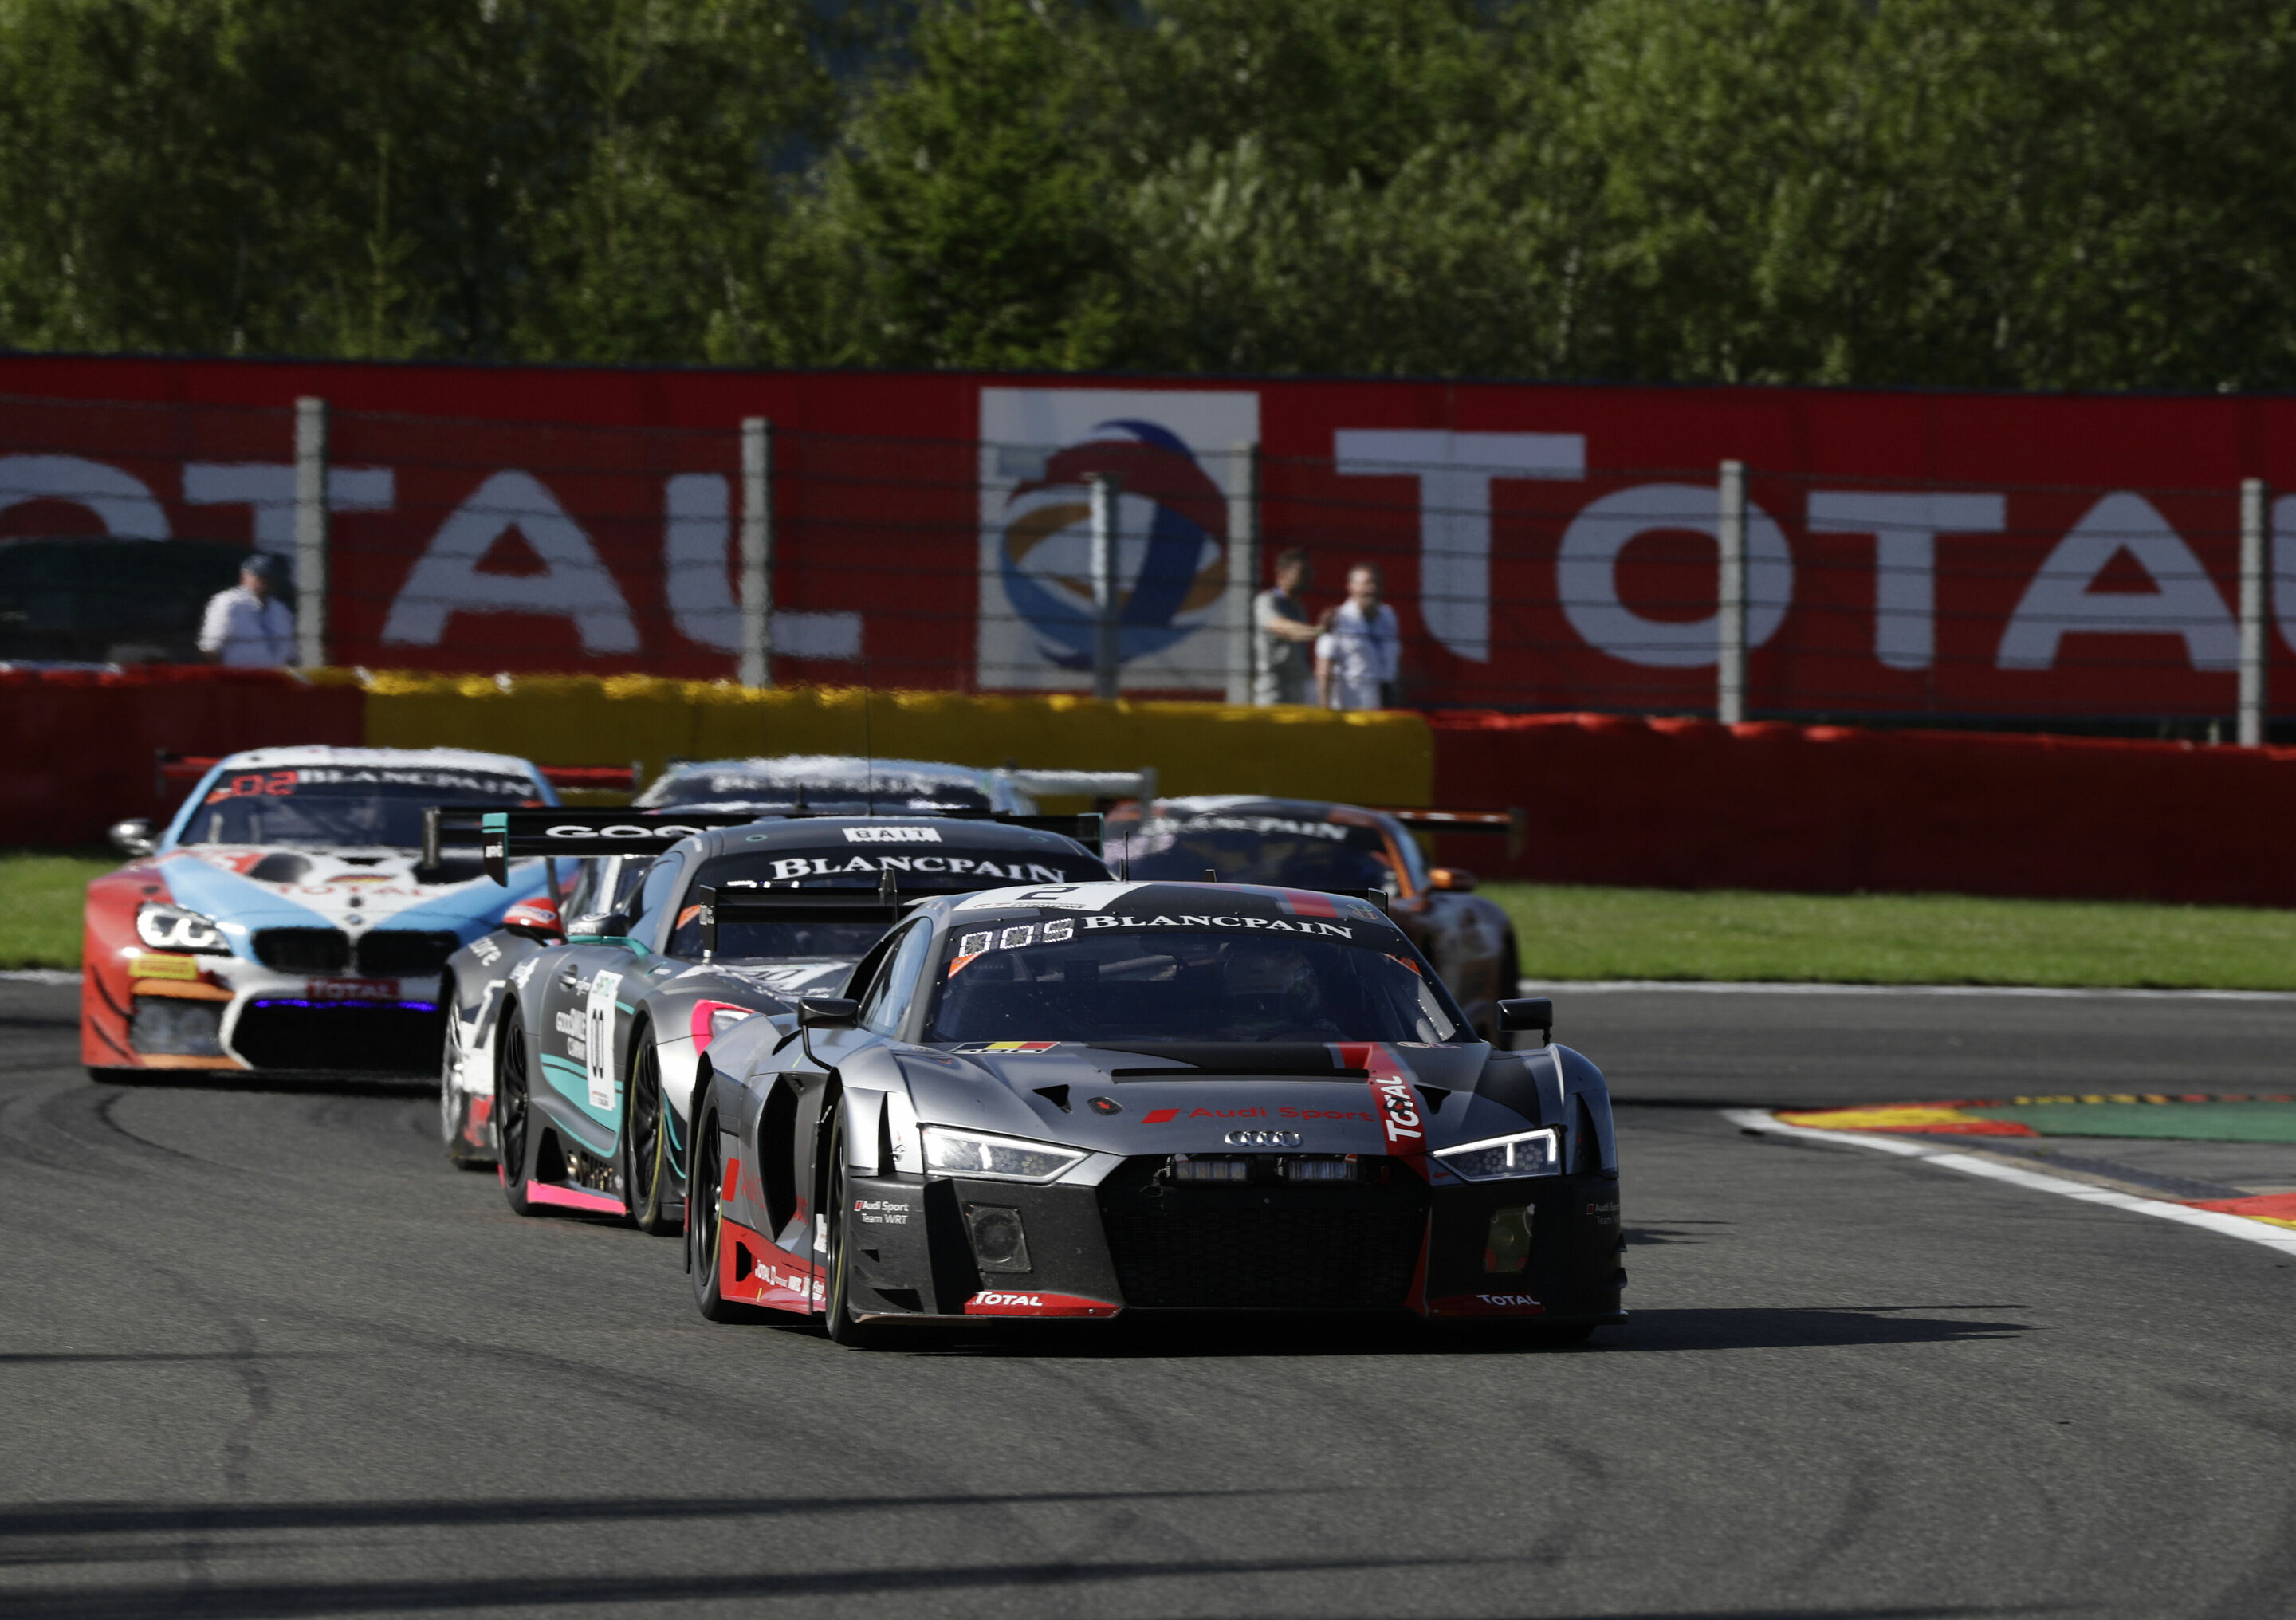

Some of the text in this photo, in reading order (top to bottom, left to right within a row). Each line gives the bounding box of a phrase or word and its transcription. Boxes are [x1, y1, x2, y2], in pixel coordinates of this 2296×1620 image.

[1334, 428, 2296, 672] TOTA
[299, 769, 536, 796] BLANCPAIN
[770, 855, 1066, 884] BLANCPAIN
[1016, 886, 1081, 901] 2
[1081, 914, 1353, 939] BLANCPAIN
[312, 979, 393, 998] TOTAL
[1189, 1107, 1375, 1121] Audi Sport
[862, 1200, 909, 1213] Audi Sport
[862, 1213, 907, 1225] Team WRT
[975, 1291, 1044, 1307] TOTAL
[1476, 1294, 1541, 1307] TOTAL
